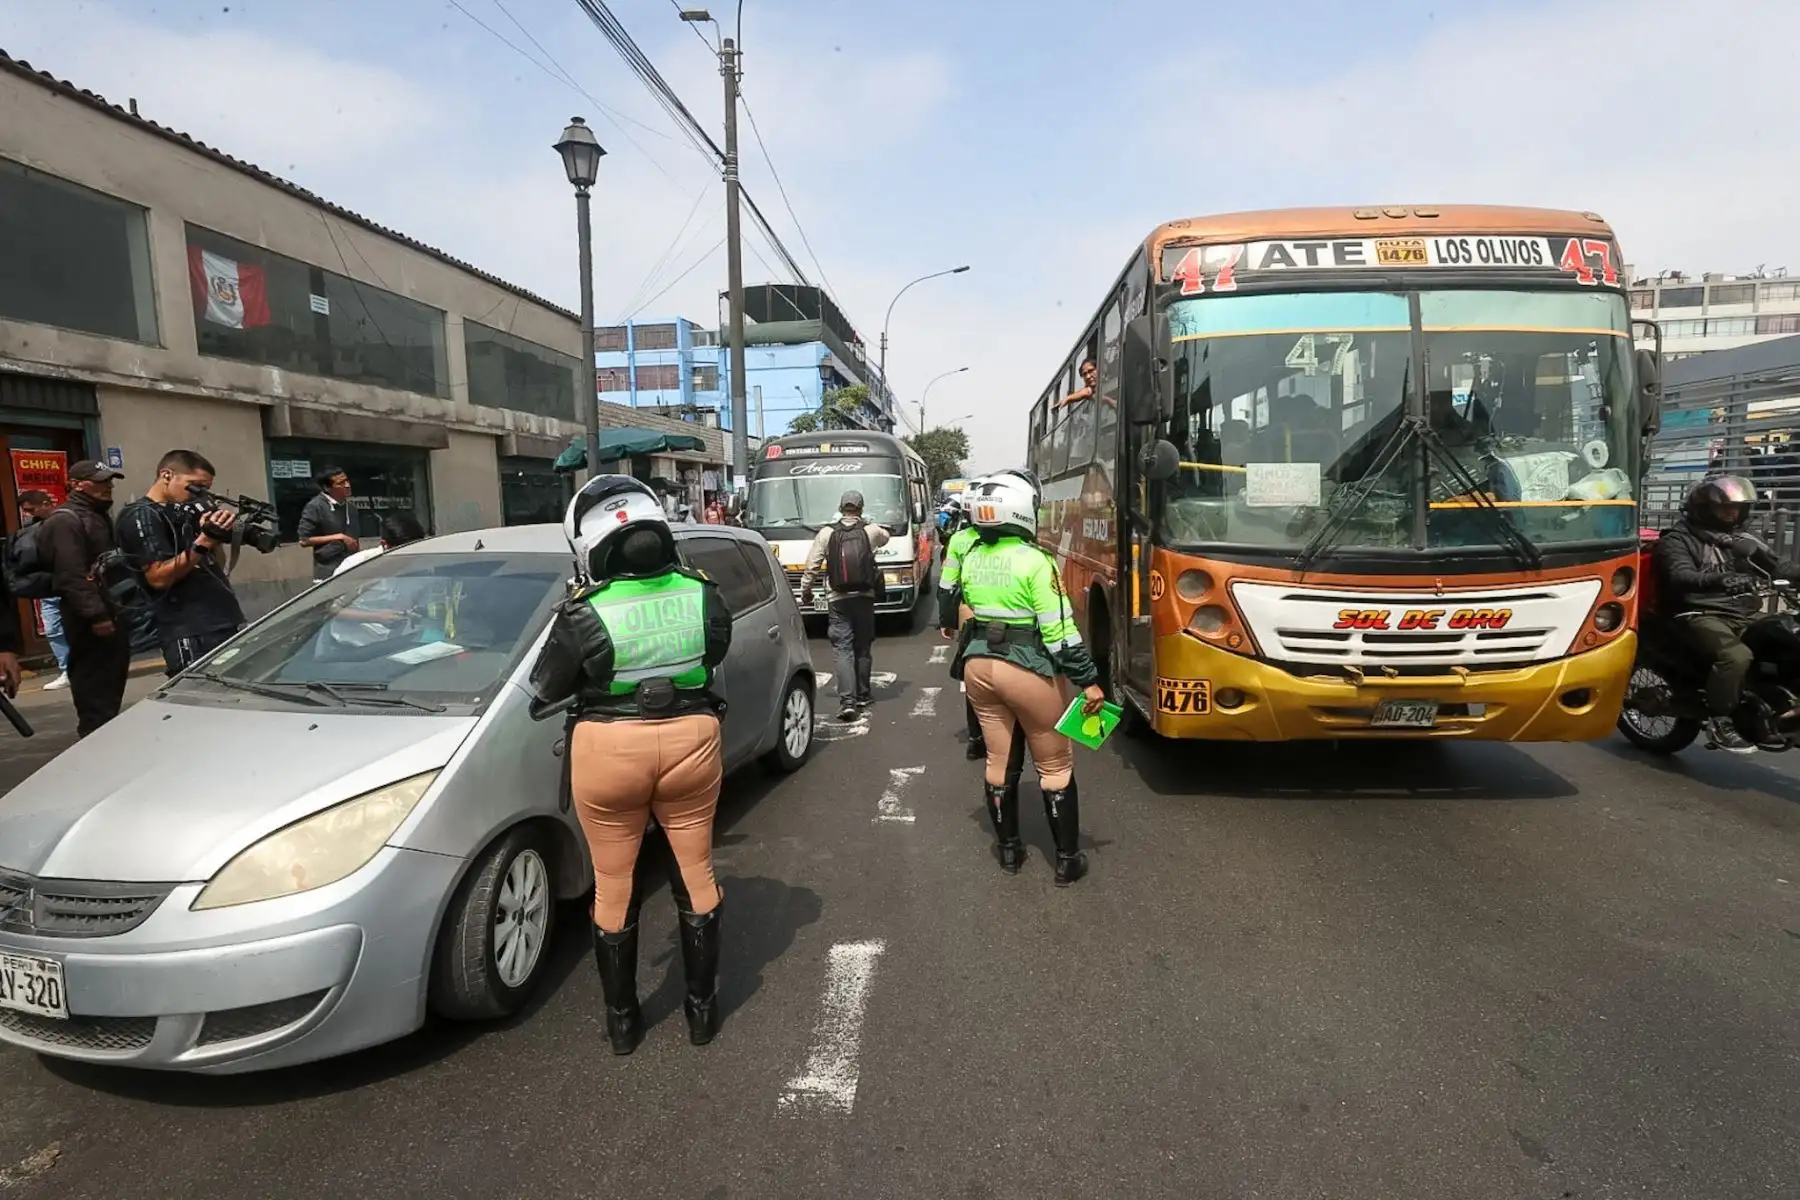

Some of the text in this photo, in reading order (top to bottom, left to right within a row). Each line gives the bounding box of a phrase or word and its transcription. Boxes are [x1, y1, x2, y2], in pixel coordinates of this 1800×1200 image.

[1259, 241, 1366, 269] ATE
[1381, 249, 1424, 261] 1476
[1434, 238, 1543, 265] LOS OLIVOS
[1559, 237, 1621, 288] 47
[1171, 245, 1244, 295] 47
[20, 460, 60, 470] CHIFA
[969, 555, 1012, 571] POLICIA
[610, 595, 701, 631] POLICIA
[1333, 608, 1512, 630] SOL DE ORO
[1158, 688, 1207, 713] 1476
